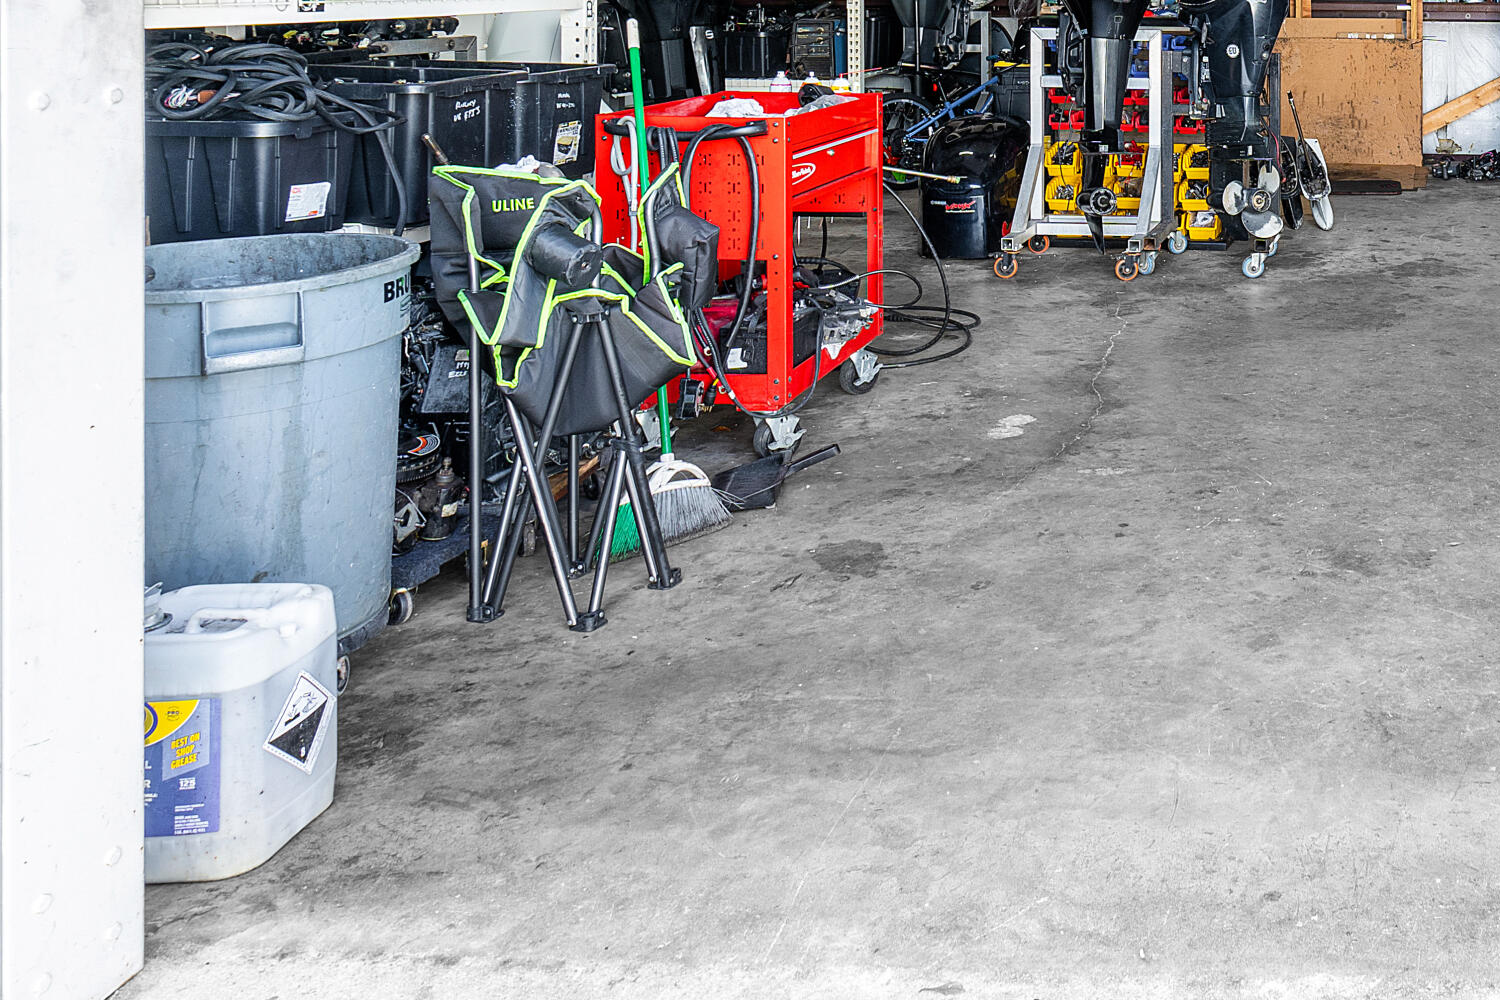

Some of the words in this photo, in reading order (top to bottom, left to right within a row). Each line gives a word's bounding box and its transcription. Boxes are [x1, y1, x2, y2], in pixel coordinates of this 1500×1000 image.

[492, 197, 535, 213] ULINE
[170, 735, 188, 750] BEST
[170, 753, 198, 770] GREASE
